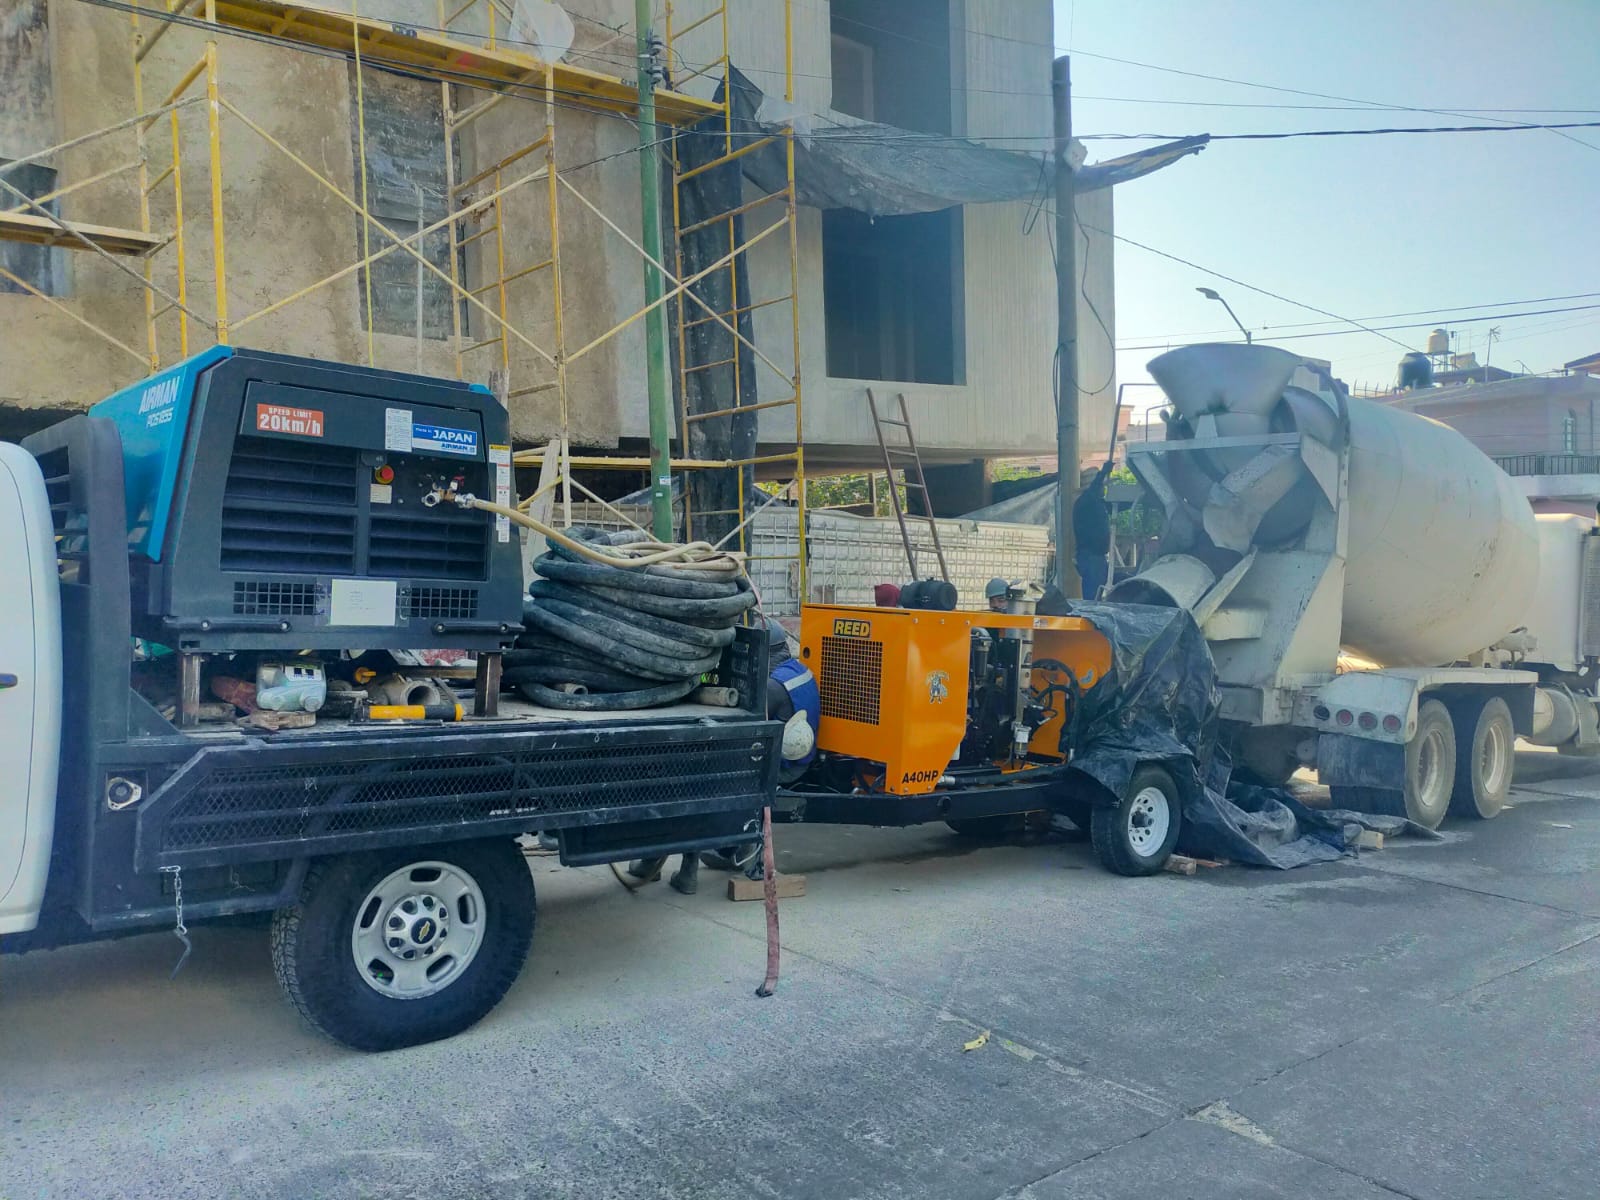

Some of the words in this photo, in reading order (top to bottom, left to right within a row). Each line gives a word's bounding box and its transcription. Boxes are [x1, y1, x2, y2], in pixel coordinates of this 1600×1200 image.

[138, 375, 180, 415] AIRMAN
[268, 407, 291, 416] SPEED
[292, 410, 313, 419] LIMIT
[259, 413, 321, 435] 20km/h
[432, 429, 473, 443] JAPAN
[441, 443, 468, 451] AIRMAN
[835, 620, 870, 637] REED
[902, 770, 939, 784] A40HP
